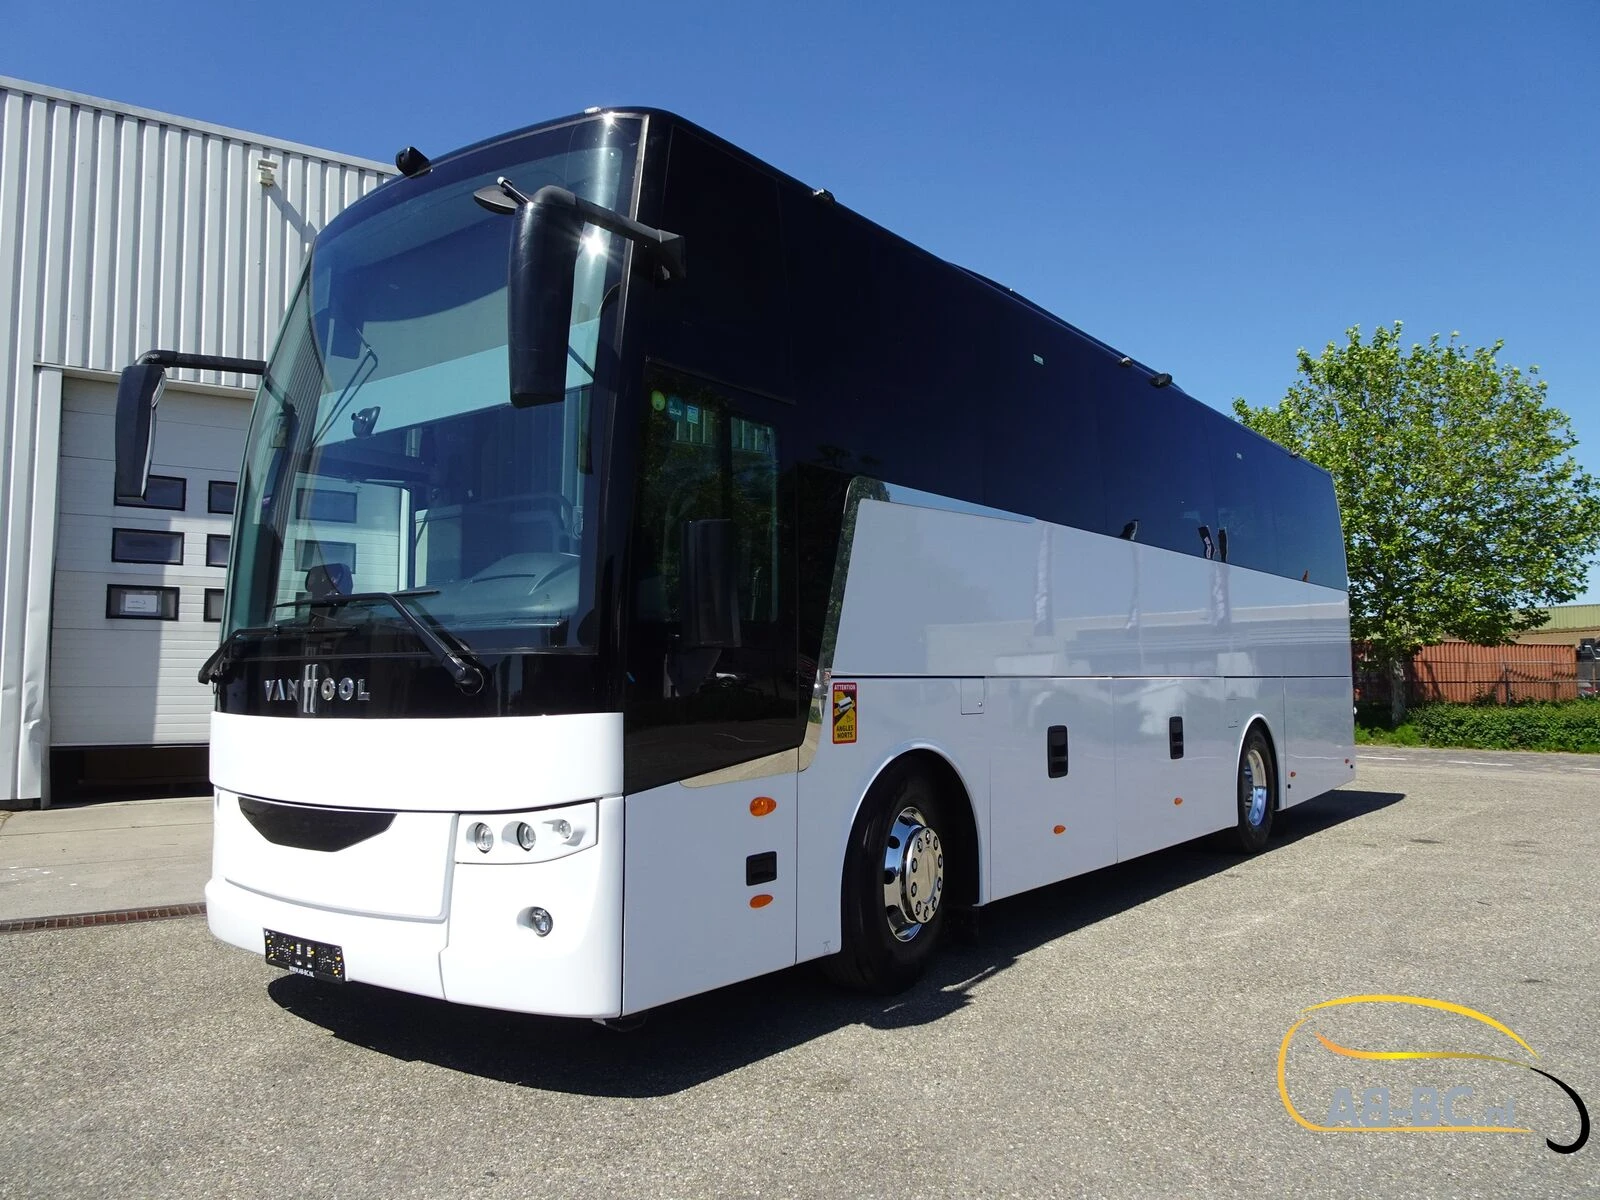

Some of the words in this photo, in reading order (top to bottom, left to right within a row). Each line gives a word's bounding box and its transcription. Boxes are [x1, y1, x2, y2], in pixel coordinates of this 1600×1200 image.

[264, 679, 299, 702] VAN
[303, 663, 370, 713] HOOL
[836, 731, 853, 739] MORTS
